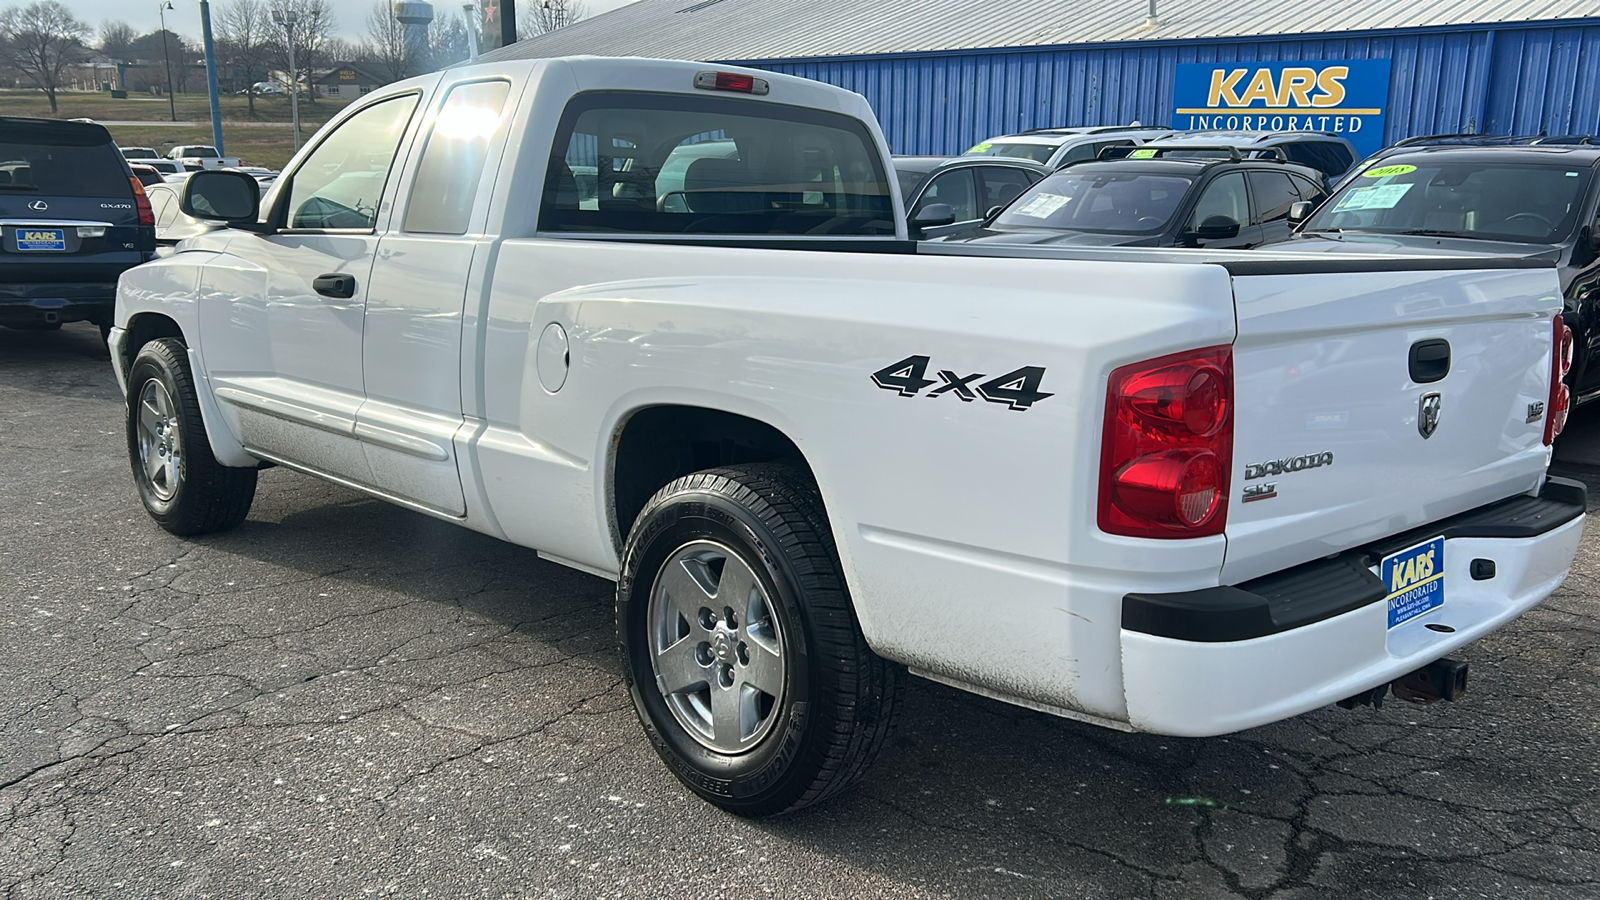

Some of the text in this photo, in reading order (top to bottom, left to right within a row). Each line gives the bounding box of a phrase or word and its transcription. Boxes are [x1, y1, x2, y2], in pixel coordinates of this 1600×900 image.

[1207, 66, 1349, 107] KARS
[1190, 115, 1362, 133] INCORPORATED
[24, 231, 57, 241] KARS
[870, 355, 1055, 411] 4x4
[1245, 450, 1333, 480] DAKOTA
[1243, 481, 1278, 498] SLT
[1391, 550, 1434, 592] KARS
[1388, 580, 1437, 611] INCORPORATED
